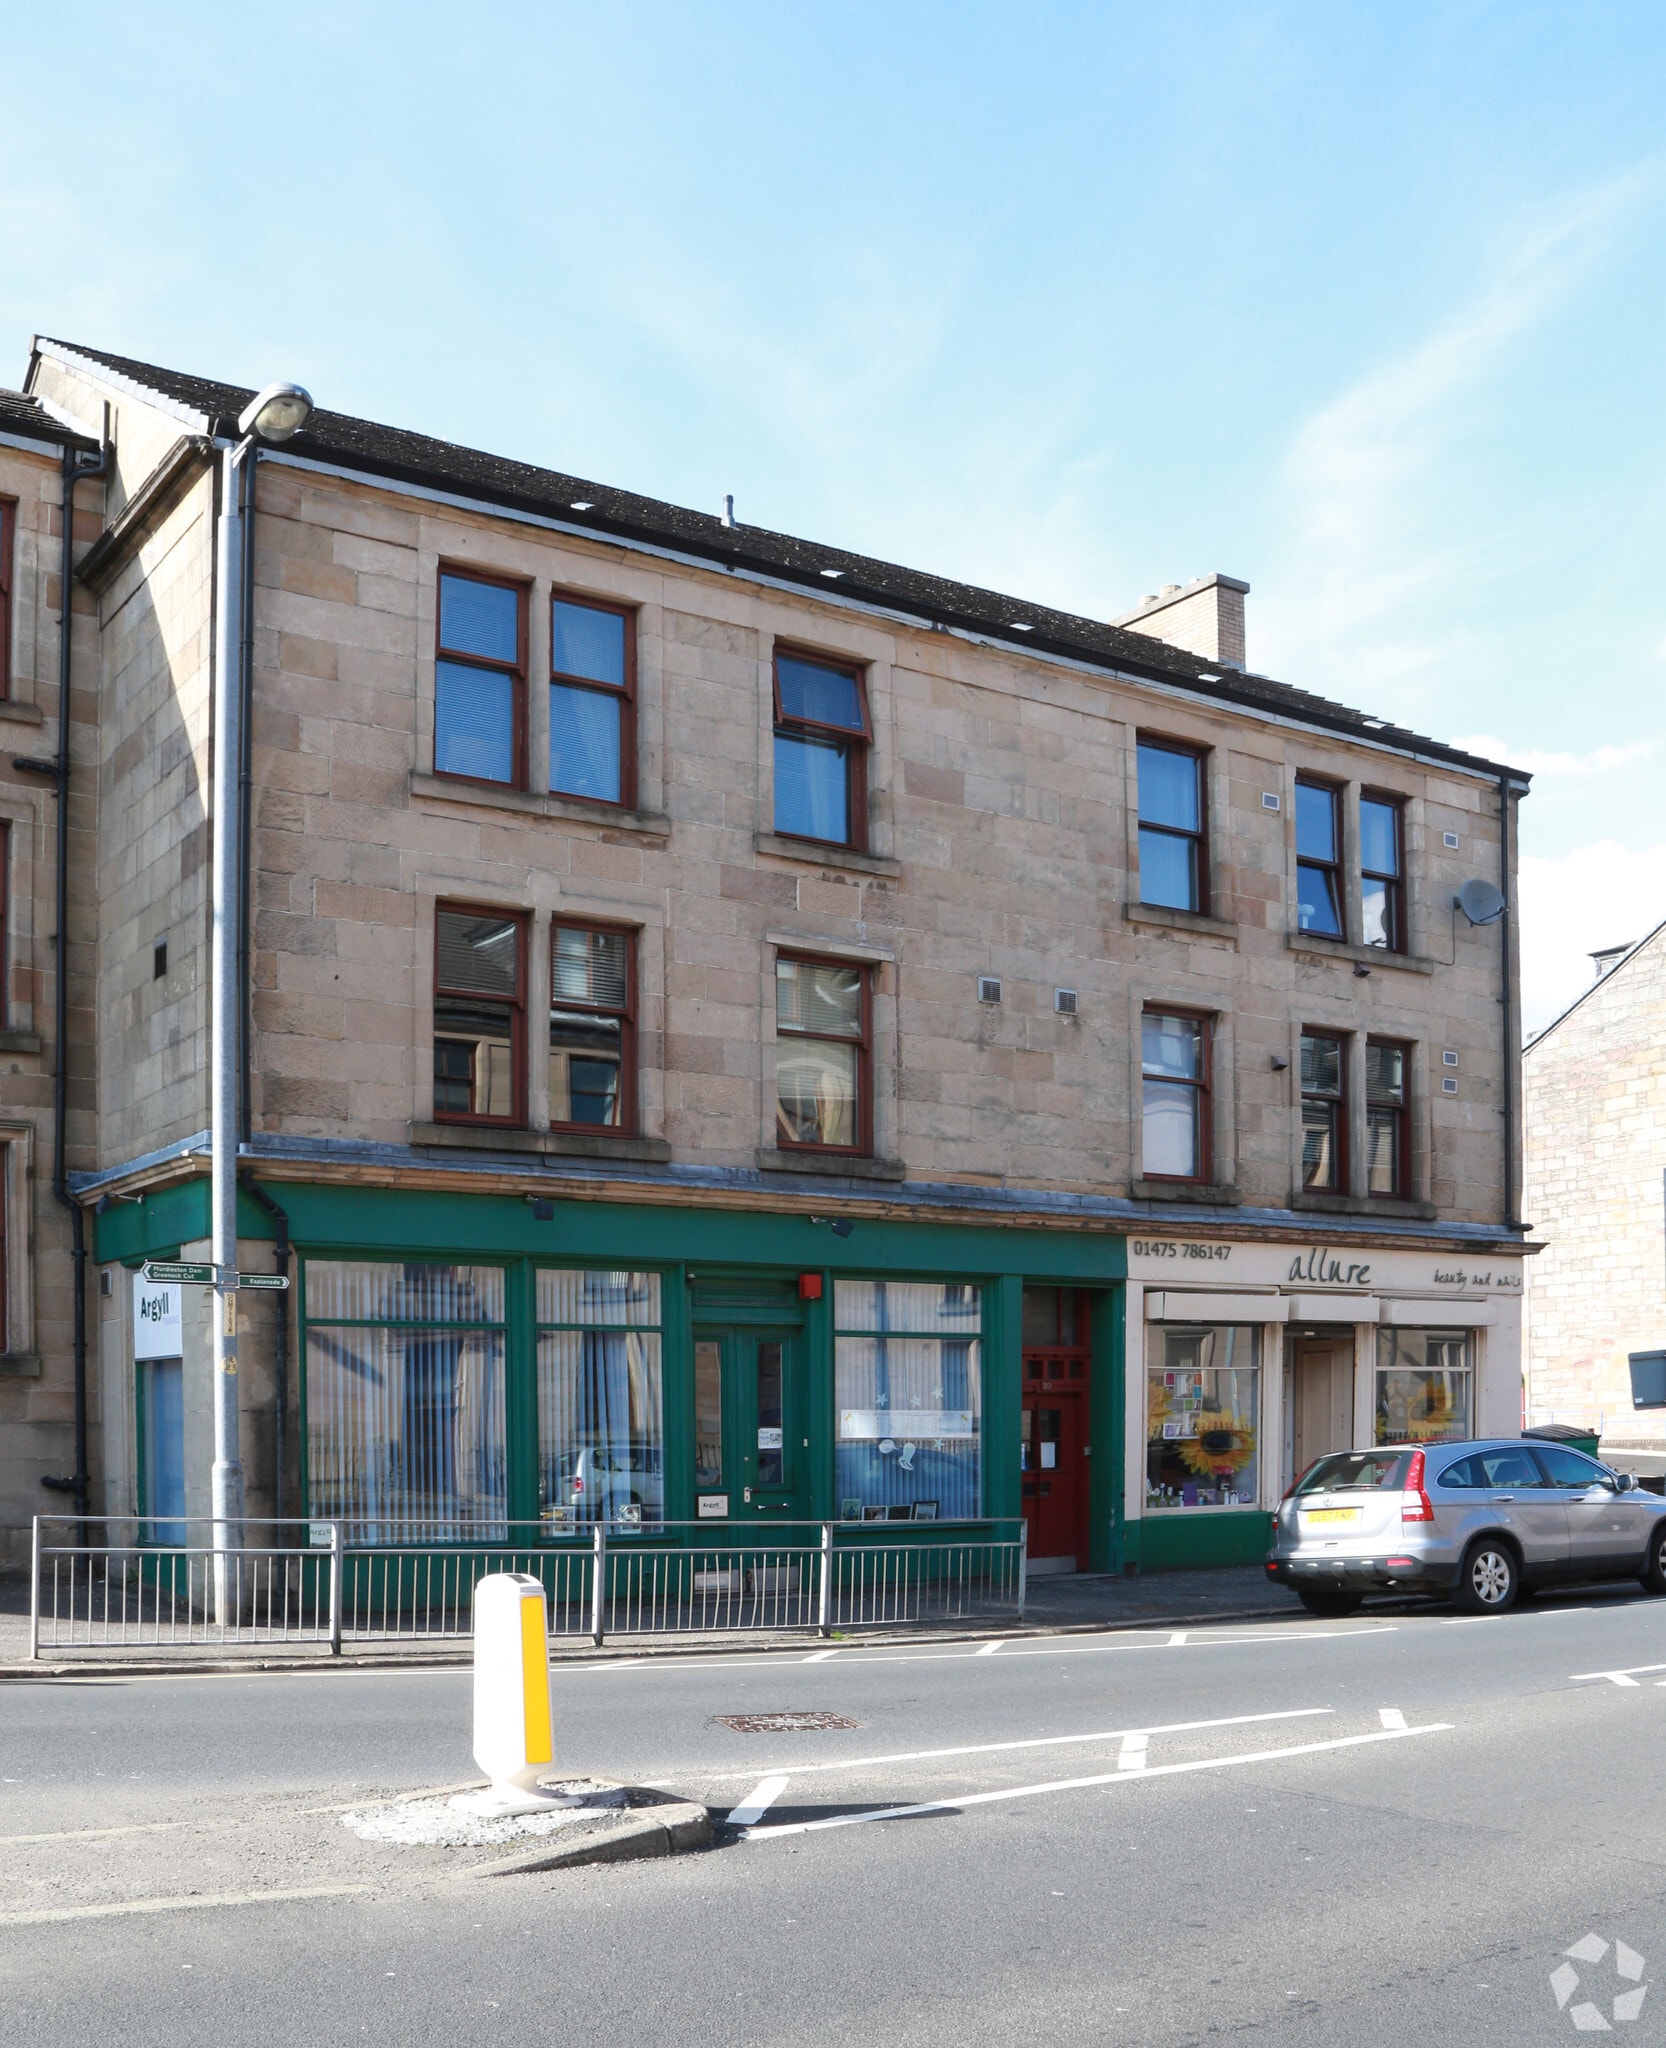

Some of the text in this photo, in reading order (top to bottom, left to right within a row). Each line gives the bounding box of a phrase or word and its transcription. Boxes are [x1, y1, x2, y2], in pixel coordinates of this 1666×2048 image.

[1134, 1240, 1231, 1261] 01475 786147
[153, 1265, 187, 1273] Murdieston
[1289, 1247, 1372, 1286] allure
[250, 1278, 281, 1286] Esplanade
[1434, 1269, 1467, 1291] beauty
[1472, 1272, 1491, 1286] and
[141, 1292, 169, 1321] Argyll
